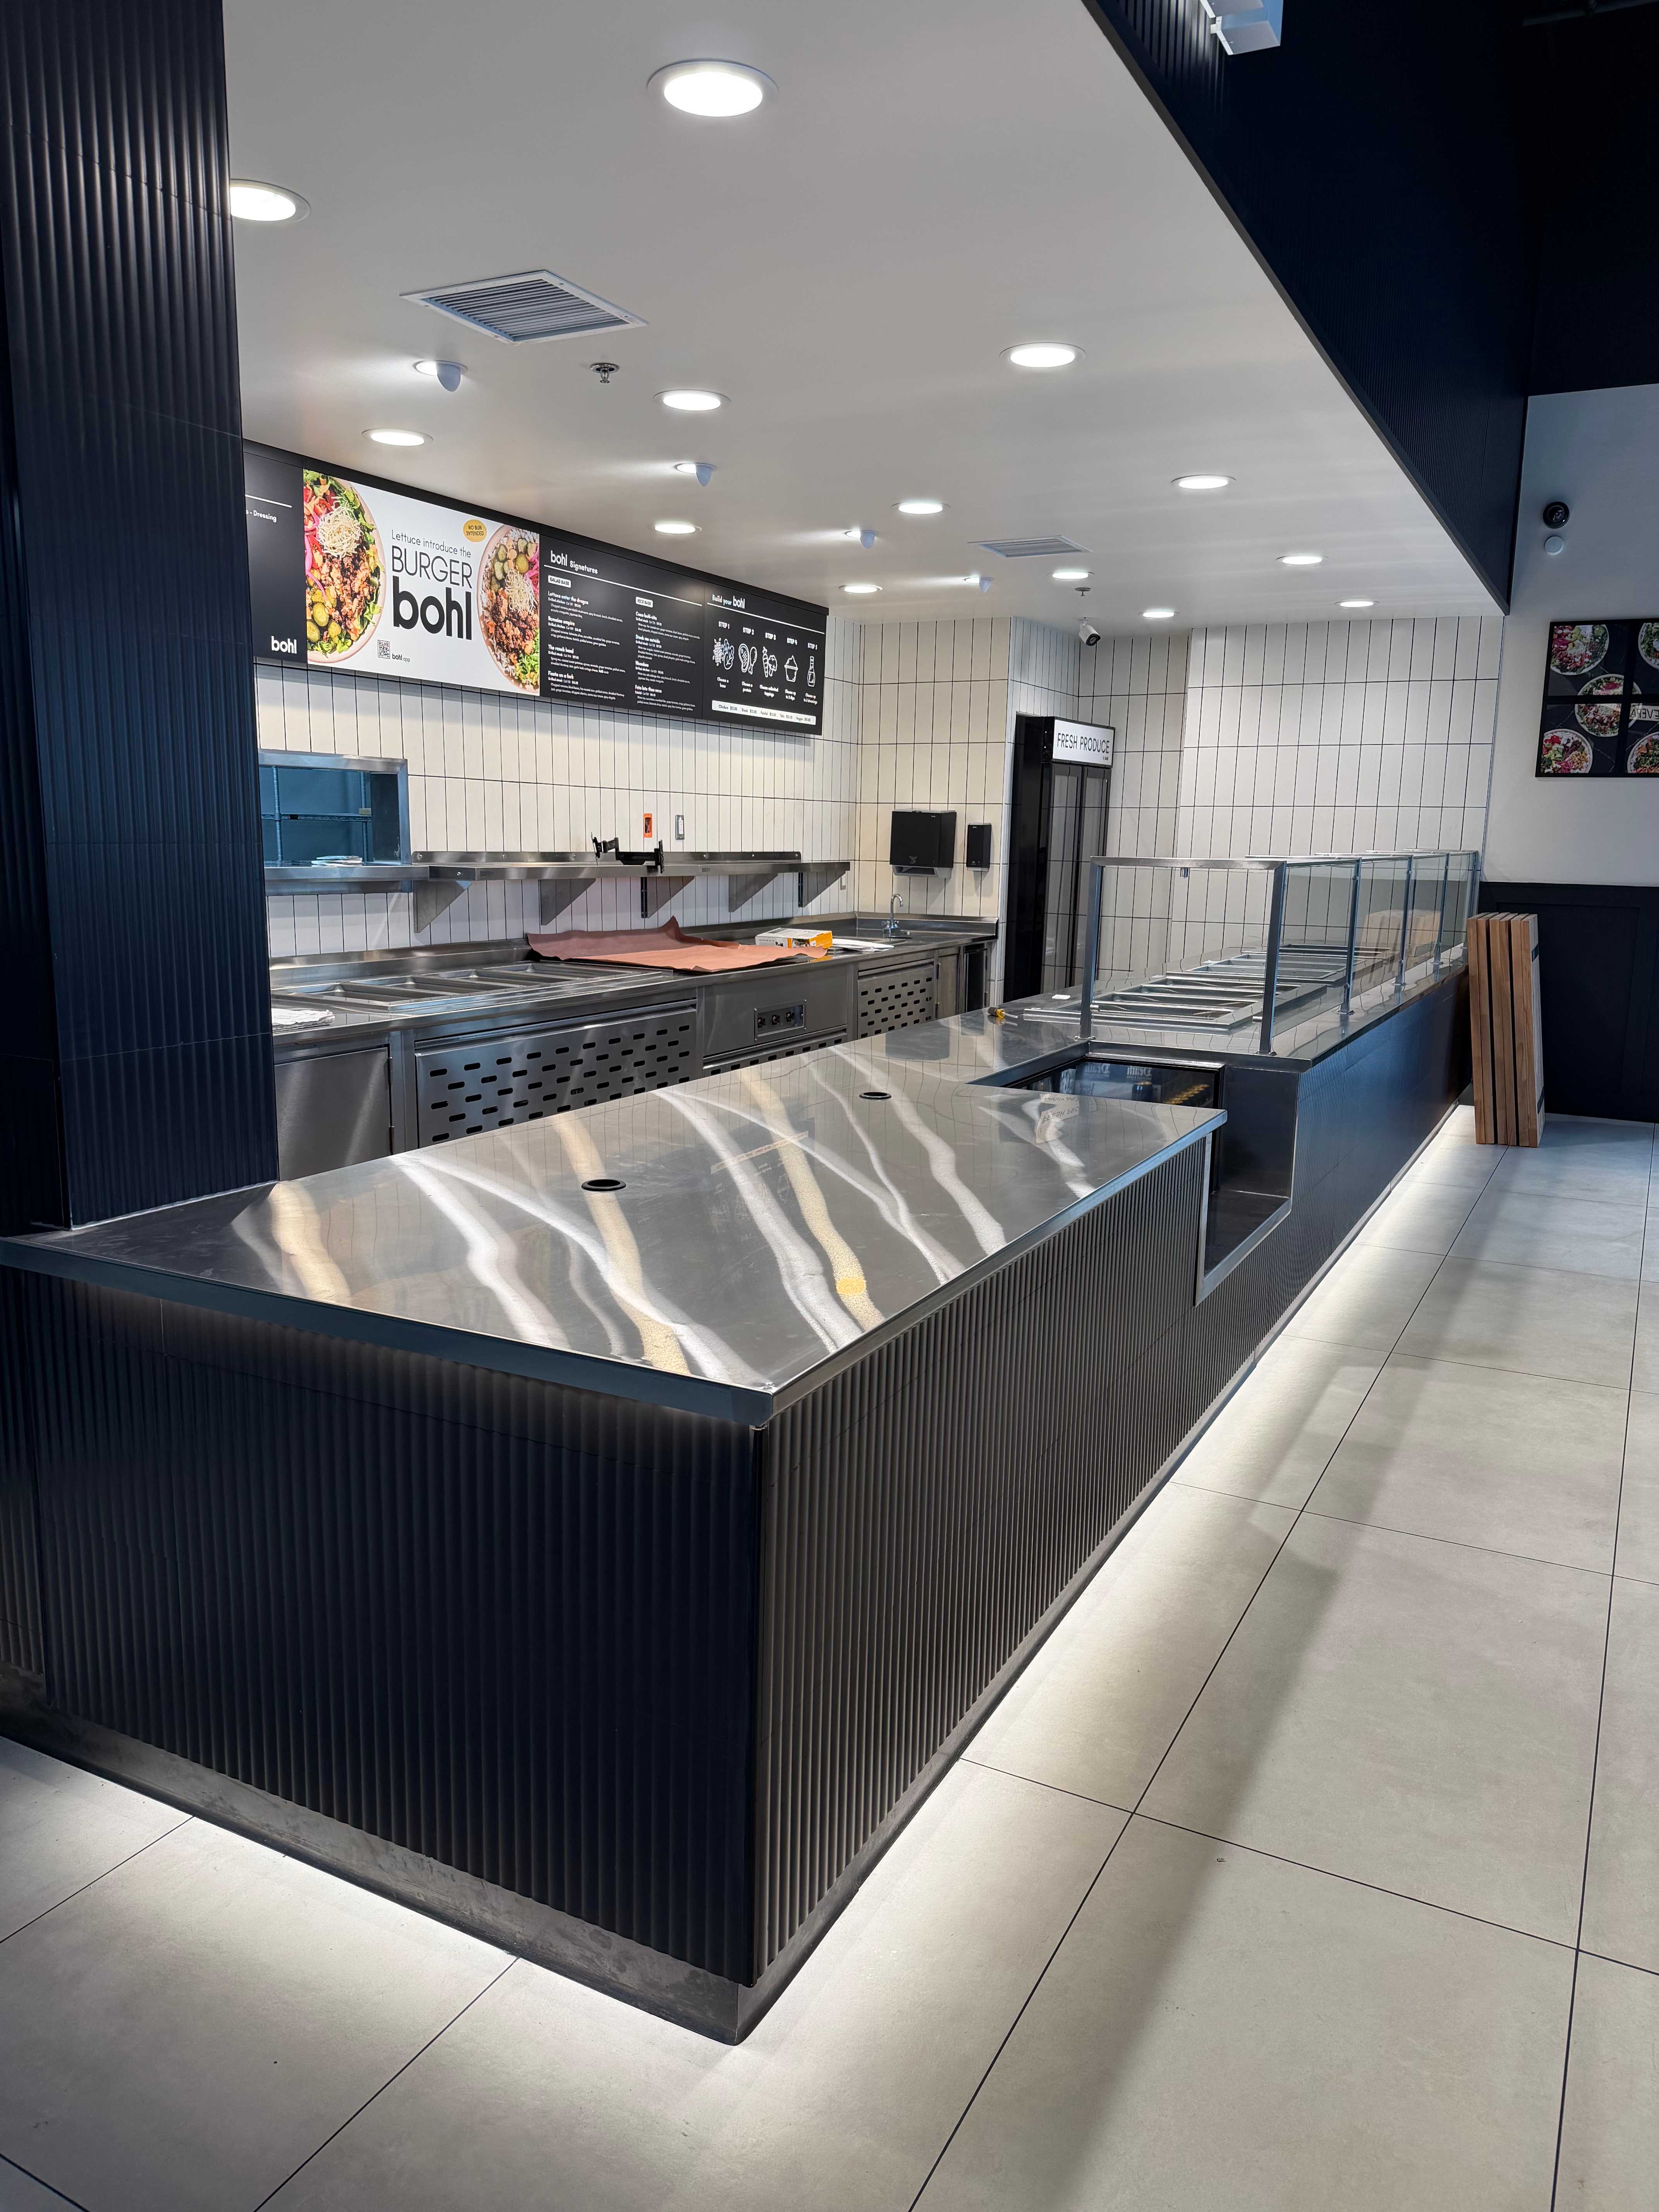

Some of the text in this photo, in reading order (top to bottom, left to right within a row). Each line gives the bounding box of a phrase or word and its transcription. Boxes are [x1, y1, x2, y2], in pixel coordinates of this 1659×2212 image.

[253, 510, 277, 523] Dressing
[392, 529, 471, 558] Lettuce introduce the
[392, 545, 472, 589] BURGER
[551, 550, 598, 574] bohl Signatures
[392, 575, 472, 641] bohl
[712, 594, 722, 603] Build
[733, 596, 745, 609] bohl
[271, 635, 297, 654] bohl
[1057, 733, 1109, 753] FRESH PRODUCE
